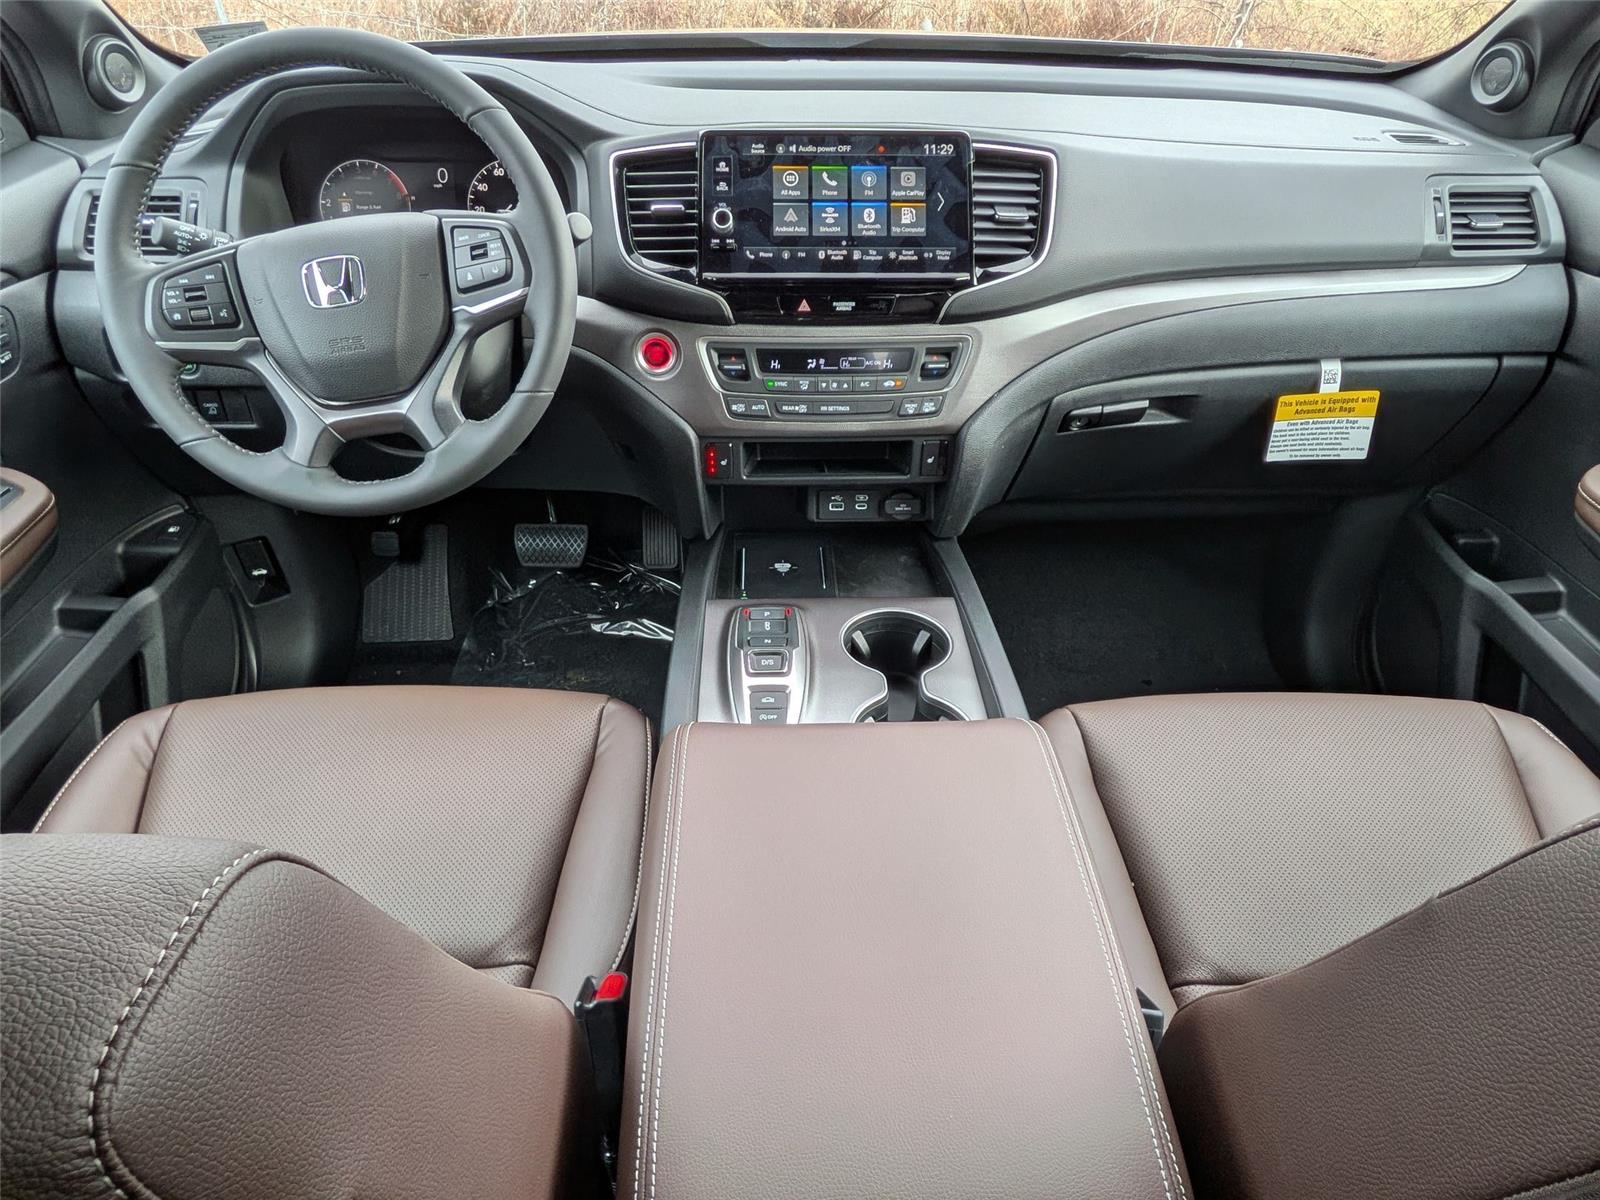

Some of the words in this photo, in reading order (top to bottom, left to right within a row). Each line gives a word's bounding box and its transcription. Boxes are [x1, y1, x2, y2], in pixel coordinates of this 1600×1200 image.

[923, 143, 954, 155] 11:29
[438, 167, 448, 183] 0
[494, 168, 504, 176] 60
[477, 183, 488, 191] 40
[174, 230, 189, 239] AUTO
[1328, 397, 1359, 405] Equipped
[1339, 406, 1355, 414] Bags
